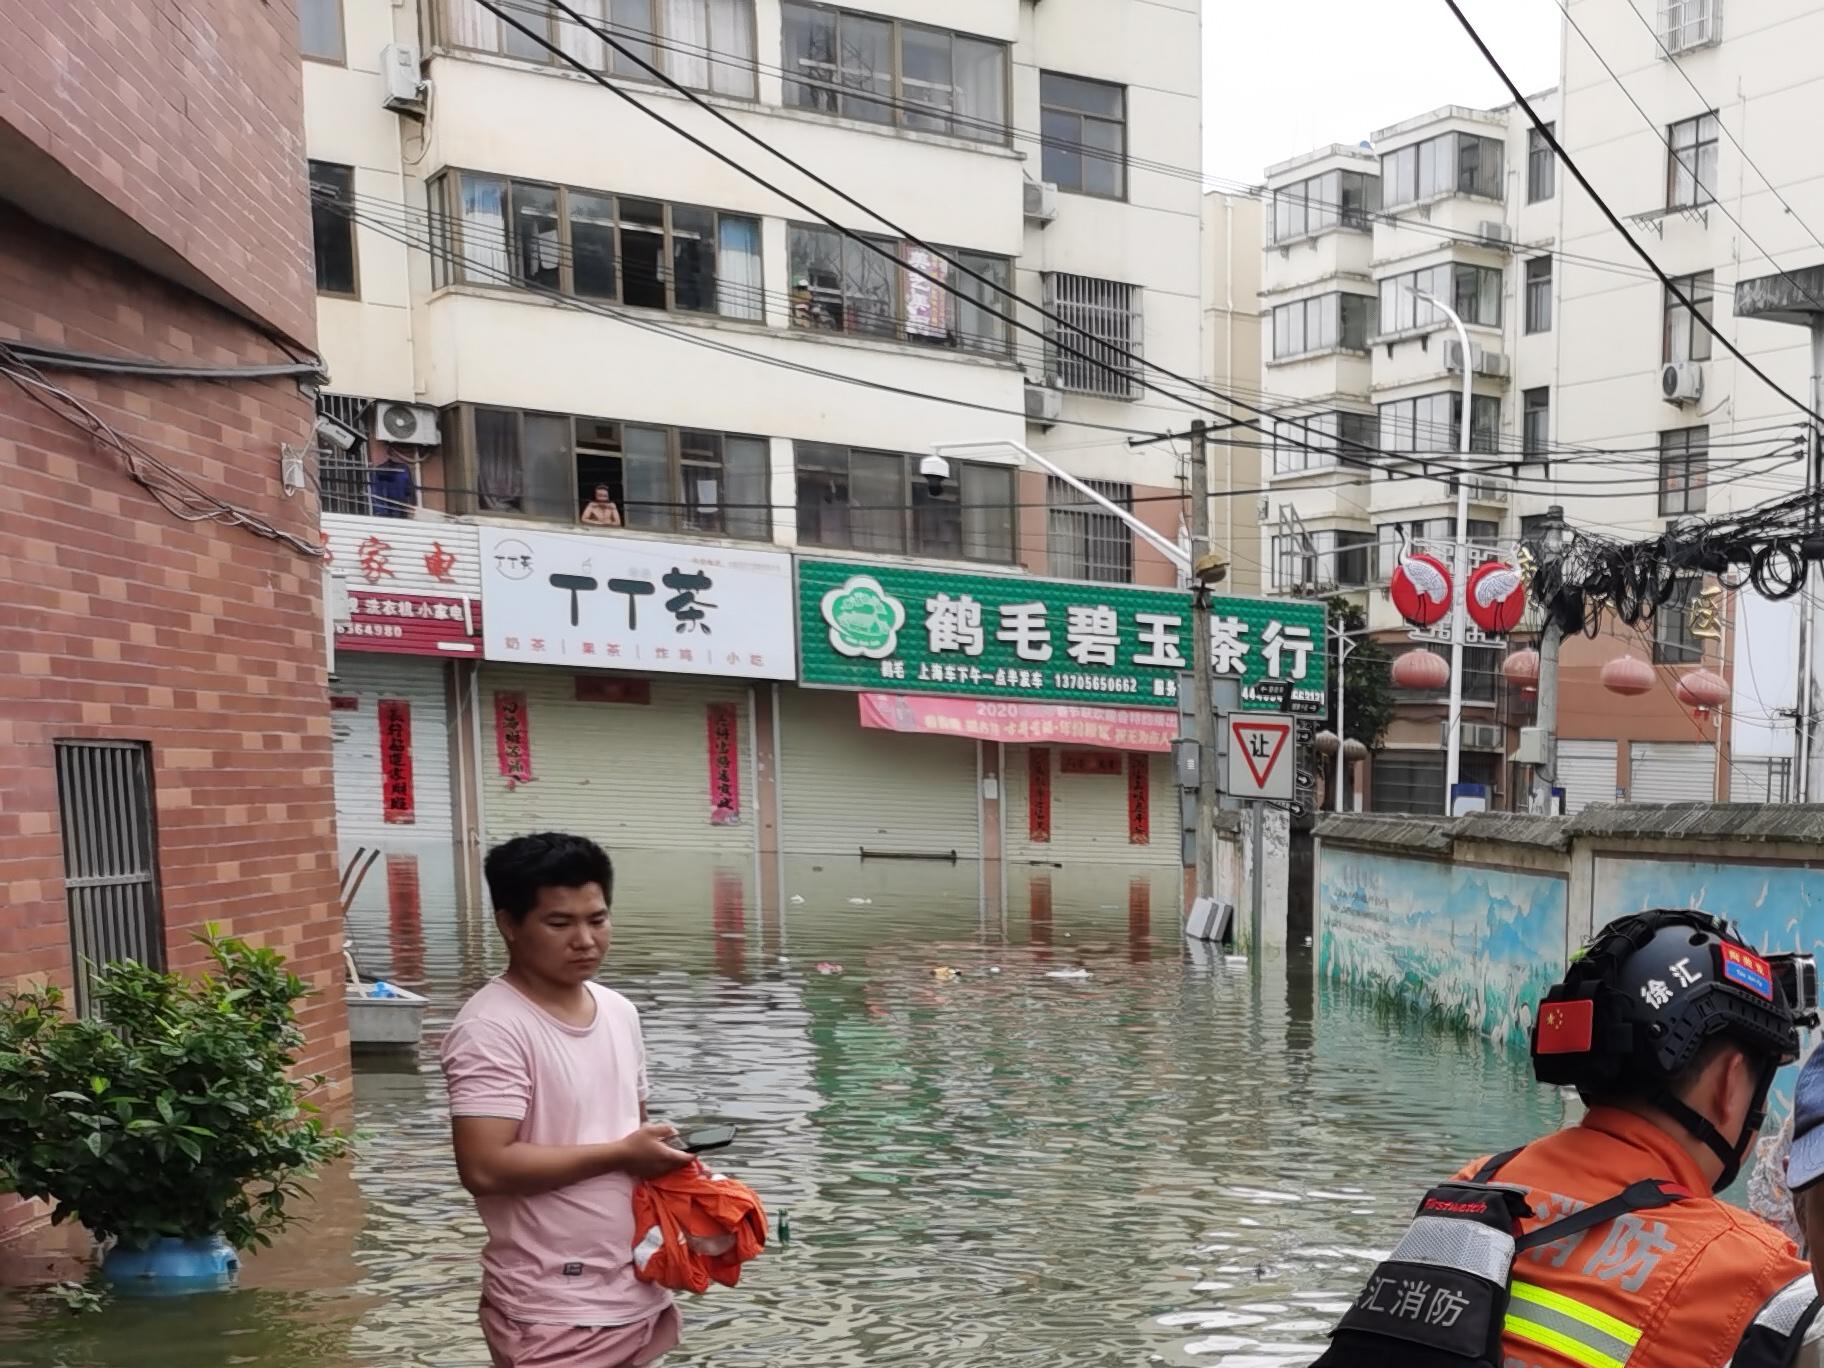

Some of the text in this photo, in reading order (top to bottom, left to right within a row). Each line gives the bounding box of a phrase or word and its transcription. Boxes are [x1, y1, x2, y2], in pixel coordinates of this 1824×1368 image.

[925, 592, 1314, 680] 鹤毛碧玉茶行
[977, 701, 1018, 717] 2020
[1054, 673, 1138, 694] 13705650662
[1250, 733, 1270, 758] 让
[1640, 956, 1703, 1011] 徐汇
[1529, 1193, 1677, 1294] 消防
[1354, 1275, 1470, 1328] 汇消防
